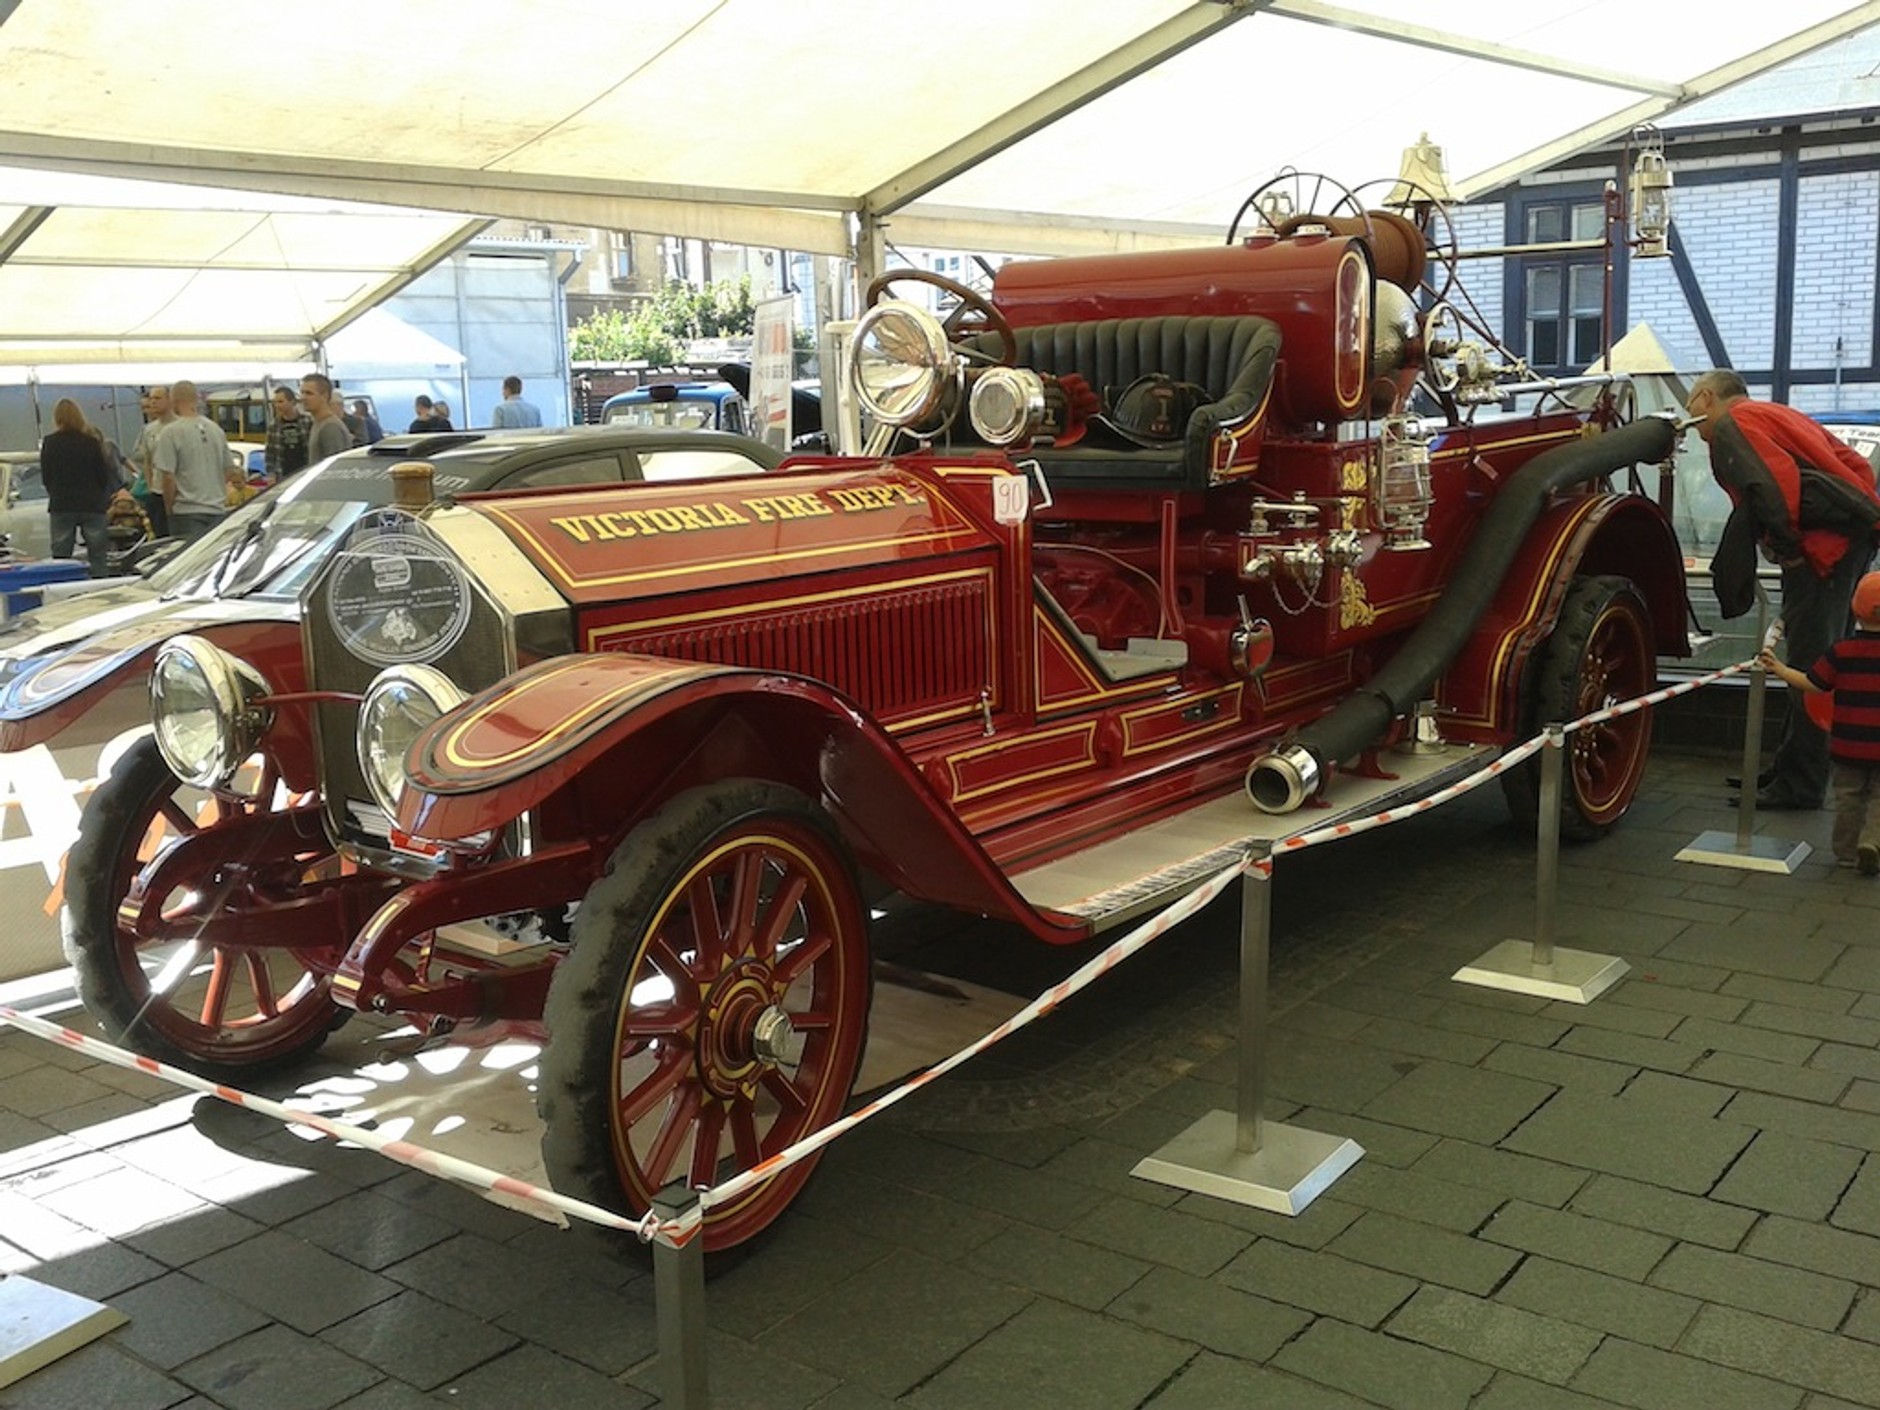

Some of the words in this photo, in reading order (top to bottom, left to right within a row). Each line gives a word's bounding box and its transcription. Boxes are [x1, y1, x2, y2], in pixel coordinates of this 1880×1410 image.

[550, 503, 751, 542] VICTORIA
[741, 493, 834, 522] FIRE
[827, 483, 926, 513] DEPT.
[999, 482, 1022, 515] 90
